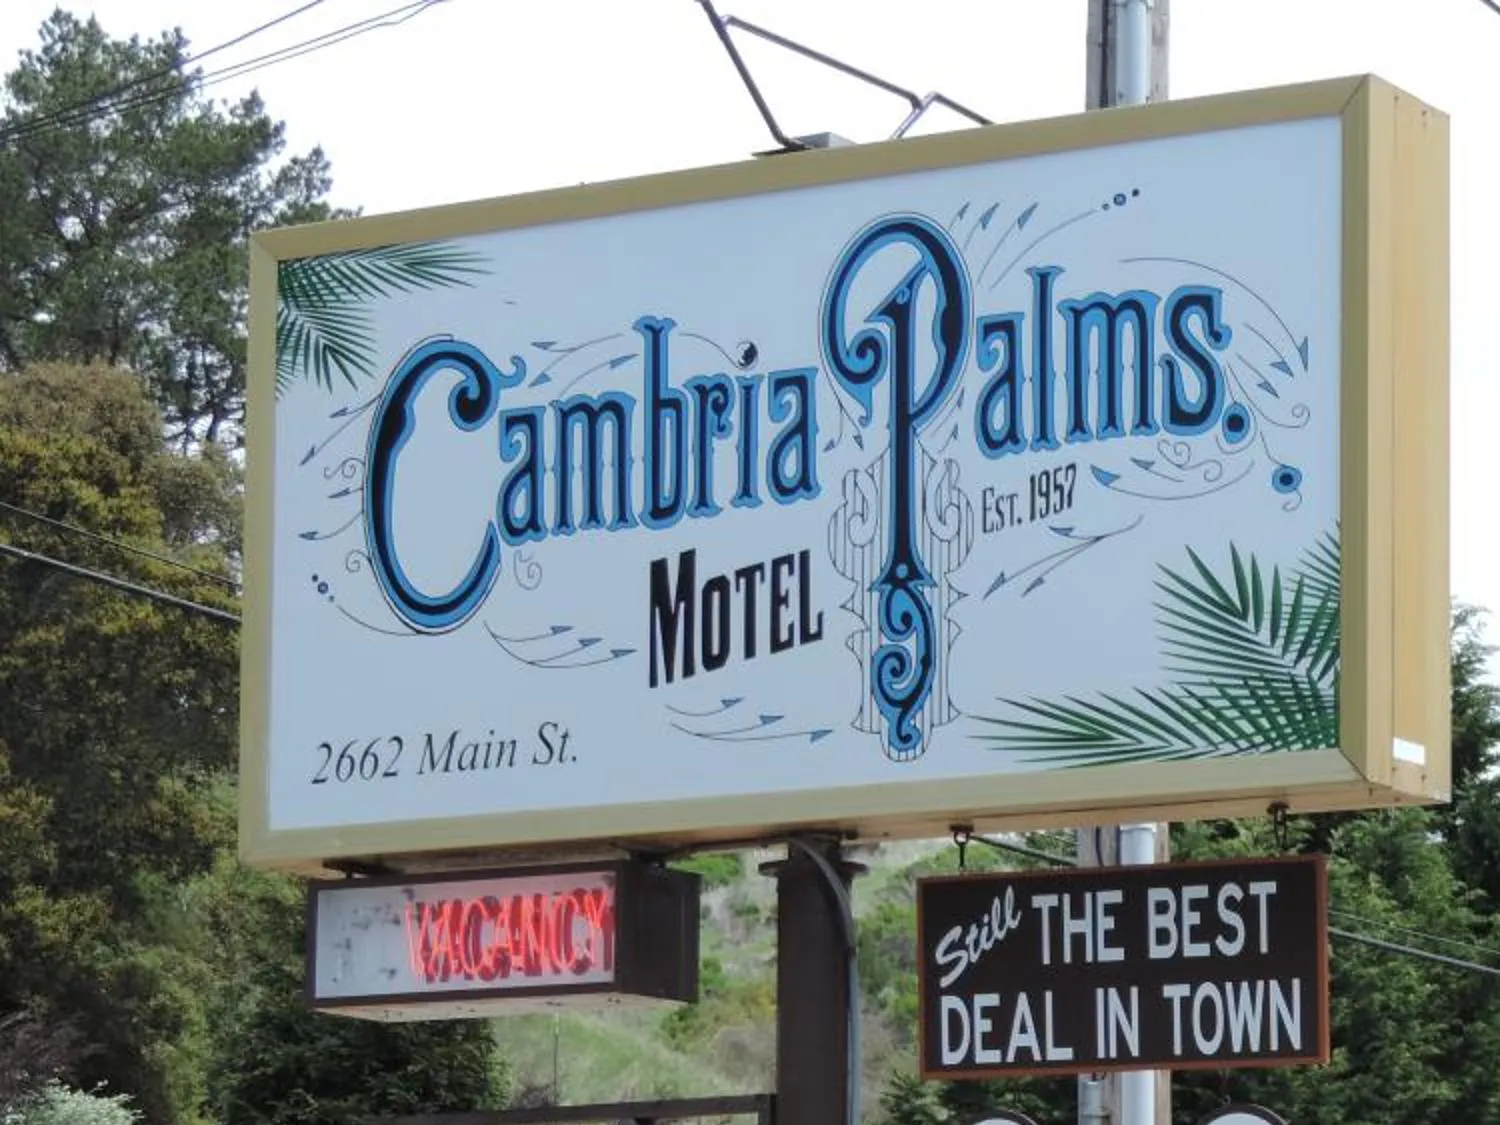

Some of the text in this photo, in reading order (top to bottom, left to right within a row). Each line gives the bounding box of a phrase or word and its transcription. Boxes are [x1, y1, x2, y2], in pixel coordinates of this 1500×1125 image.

[364, 315, 822, 634] Cambria
[1029, 462, 1077, 523] 1957
[311, 720, 577, 785] 2662 Main St.
[405, 886, 617, 984] VACANCY
[935, 881, 1277, 989] Still THE BEST
[940, 977, 1302, 1066] DEAL IN TOWN
